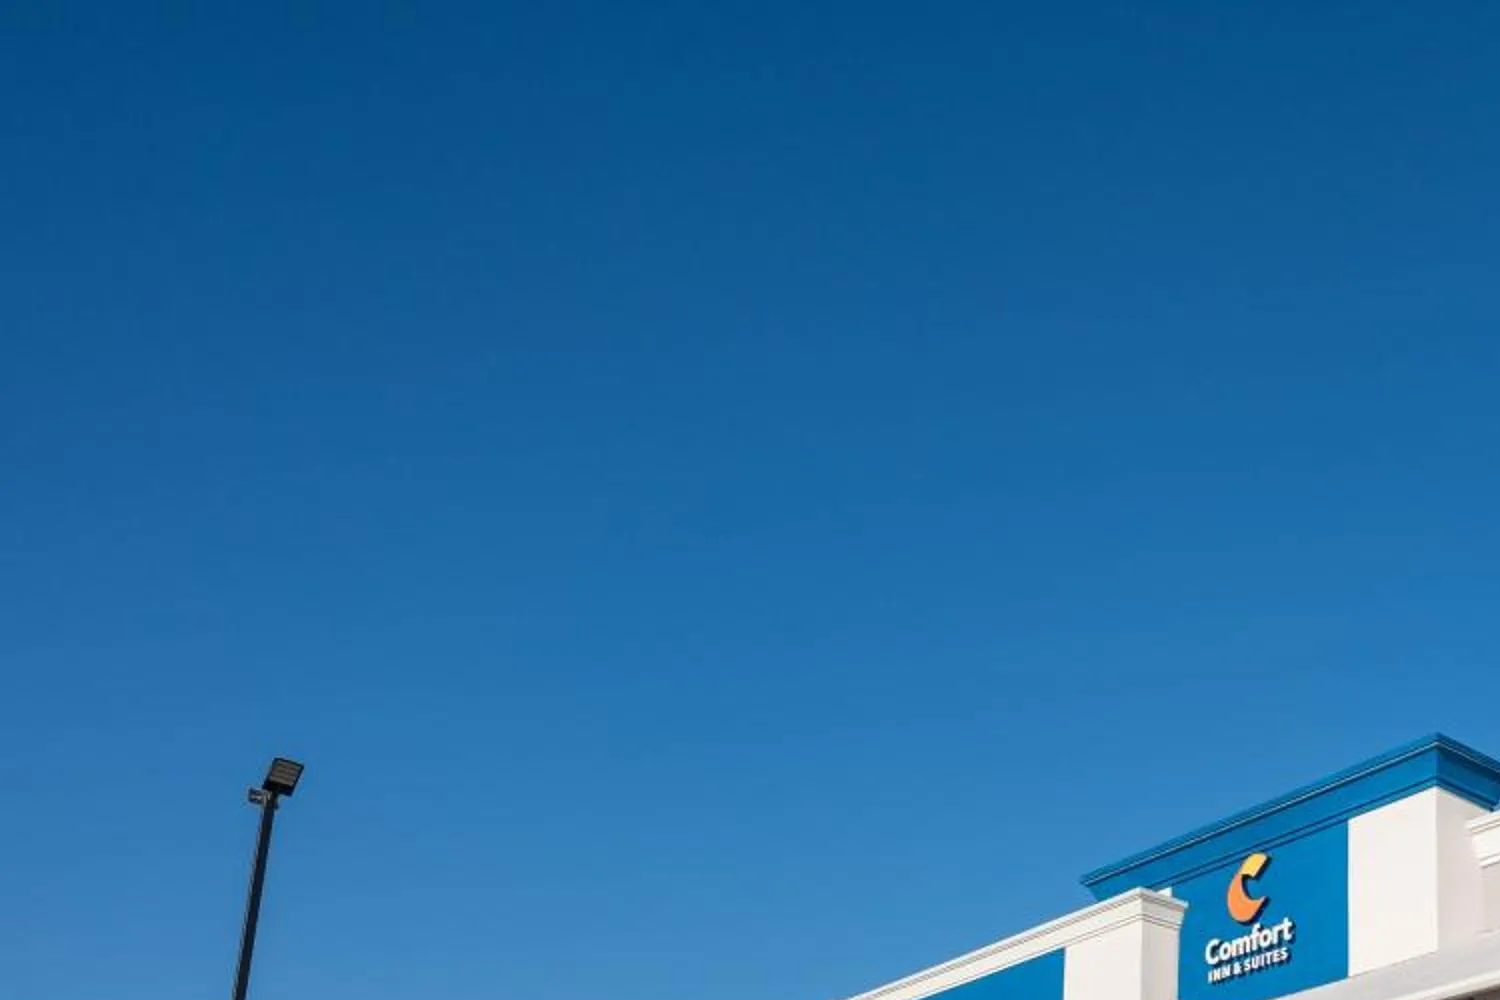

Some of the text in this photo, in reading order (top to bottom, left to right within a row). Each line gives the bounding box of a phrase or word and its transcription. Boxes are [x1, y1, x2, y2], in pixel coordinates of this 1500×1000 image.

[1205, 917, 1293, 965] Comfort
[1208, 947, 1288, 984] INN & SUITES
